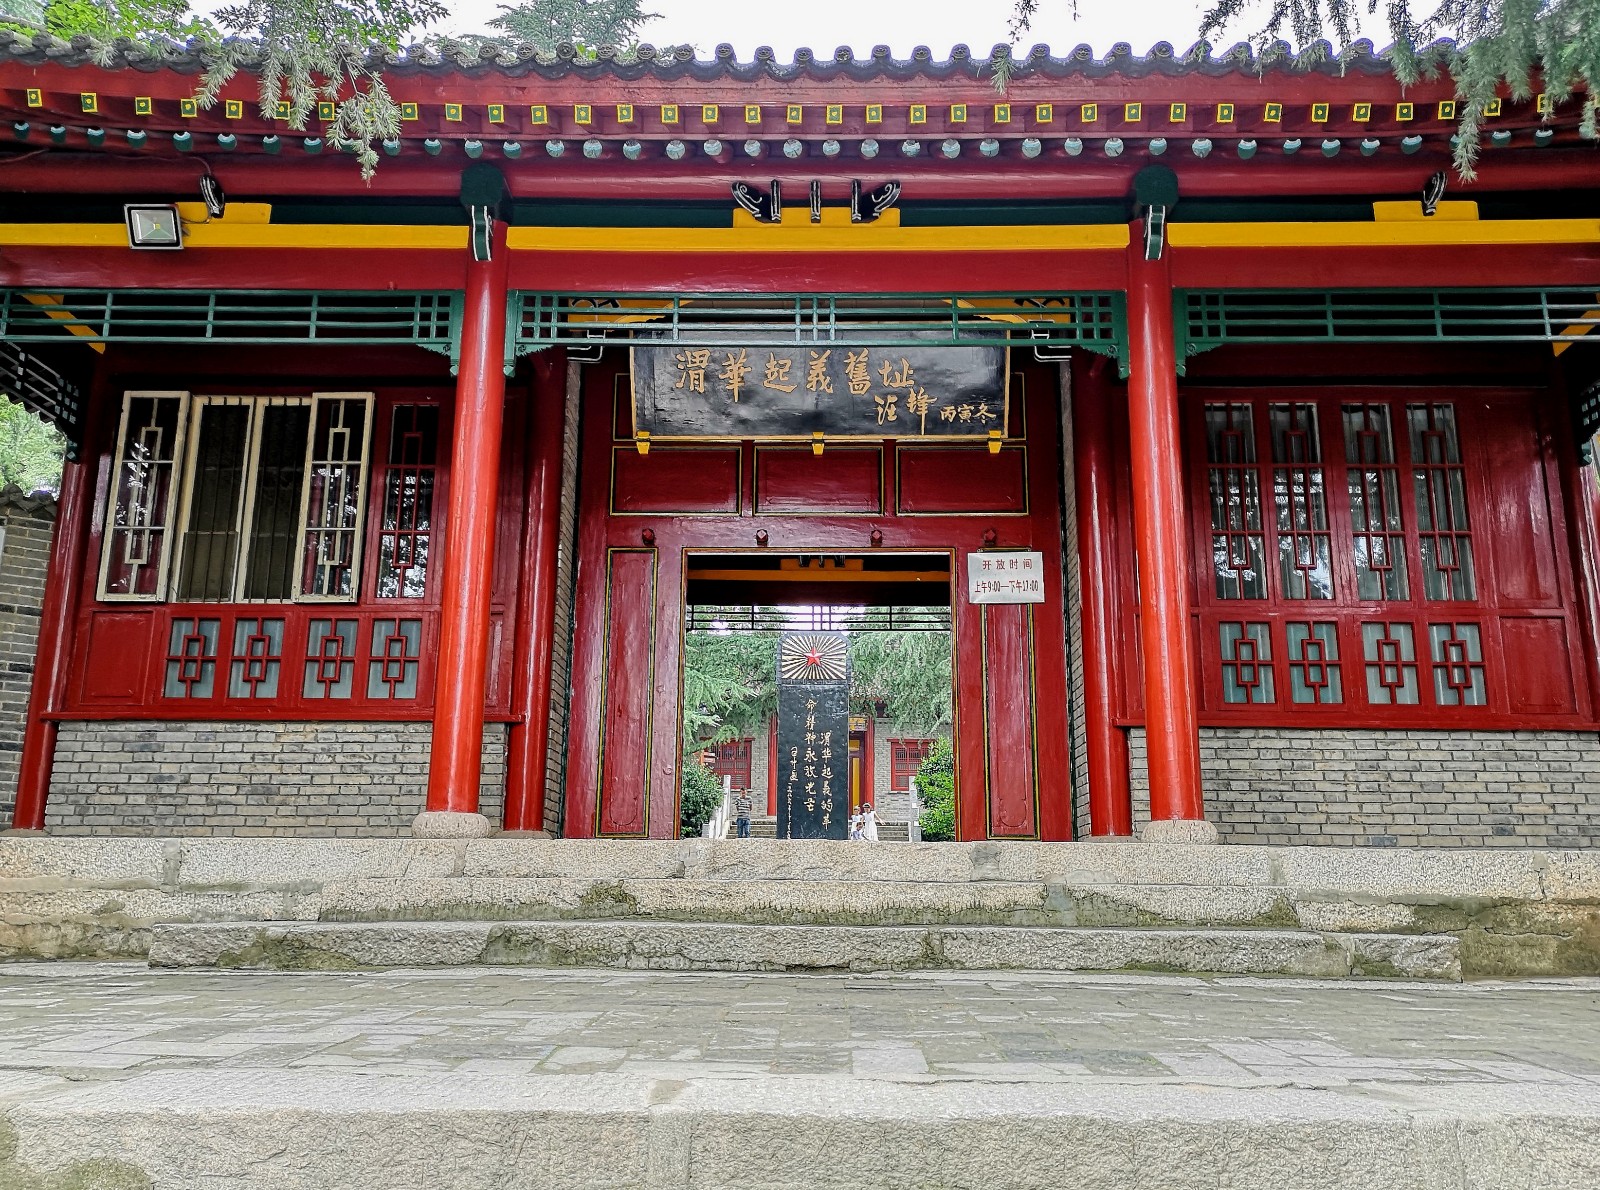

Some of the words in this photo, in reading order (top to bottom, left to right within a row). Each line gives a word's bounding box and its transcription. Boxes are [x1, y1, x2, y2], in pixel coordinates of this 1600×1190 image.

[675, 348, 915, 402] 渭華起義舊址
[940, 403, 997, 424] 丙寅冬
[982, 558, 1033, 571] 开放时间
